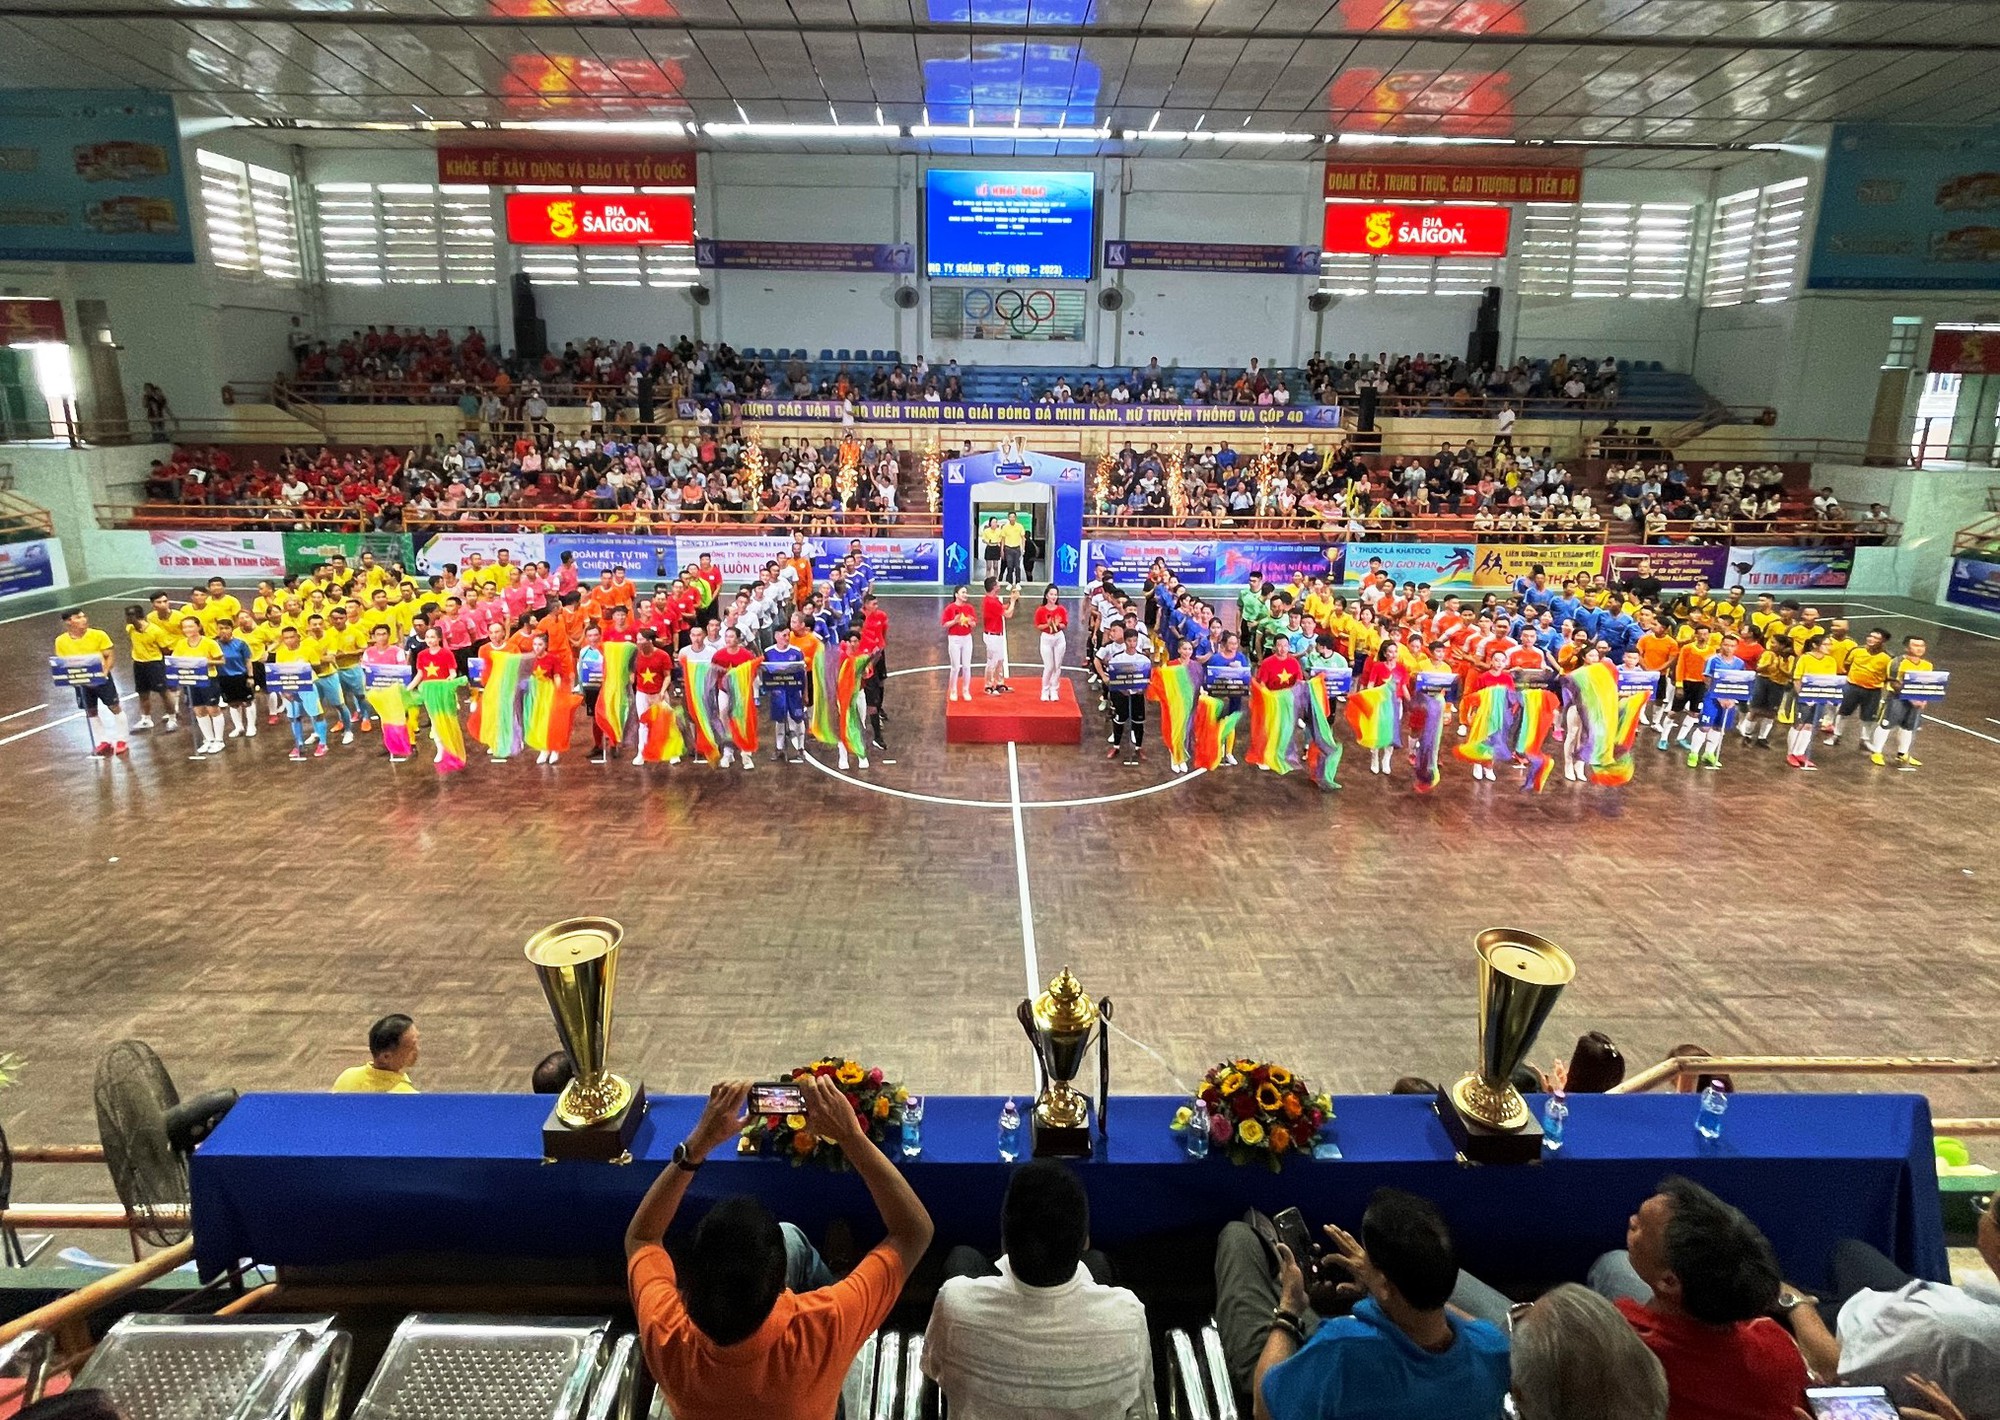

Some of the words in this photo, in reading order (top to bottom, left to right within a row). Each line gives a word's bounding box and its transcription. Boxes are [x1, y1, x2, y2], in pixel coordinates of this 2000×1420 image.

[531, 160, 564, 182] DỰNG
[654, 159, 686, 181] QUỐC
[1385, 174, 1417, 191] TRUNG
[1453, 175, 1473, 193] CAO
[605, 206, 626, 217] BIA
[1422, 217, 1443, 227] BIA
[944, 262, 954, 275] TY
[778, 402, 802, 417] CÁC
[806, 403, 830, 419] VẬN
[872, 403, 900, 419] VIÊN
[904, 406, 940, 420] THAM
[943, 407, 965, 420] GIA
[968, 404, 994, 420] GIẢI
[997, 405, 1031, 421] BÓNG
[1055, 408, 1086, 421] MINI
[1126, 406, 1144, 422] NỮ
[1147, 406, 1192, 423] TRUYỀN
[1196, 405, 1237, 422] THỐNG
[1240, 408, 1255, 422] VÀ
[1287, 410, 1304, 423] 40
[572, 549, 600, 560] ĐOÀN
[600, 549, 615, 560] KẾT
[633, 552, 648, 561] TIN
[1396, 548, 1431, 556] KHATOCO
[582, 561, 608, 571] CHIẾN
[723, 560, 750, 574] LUÔN
